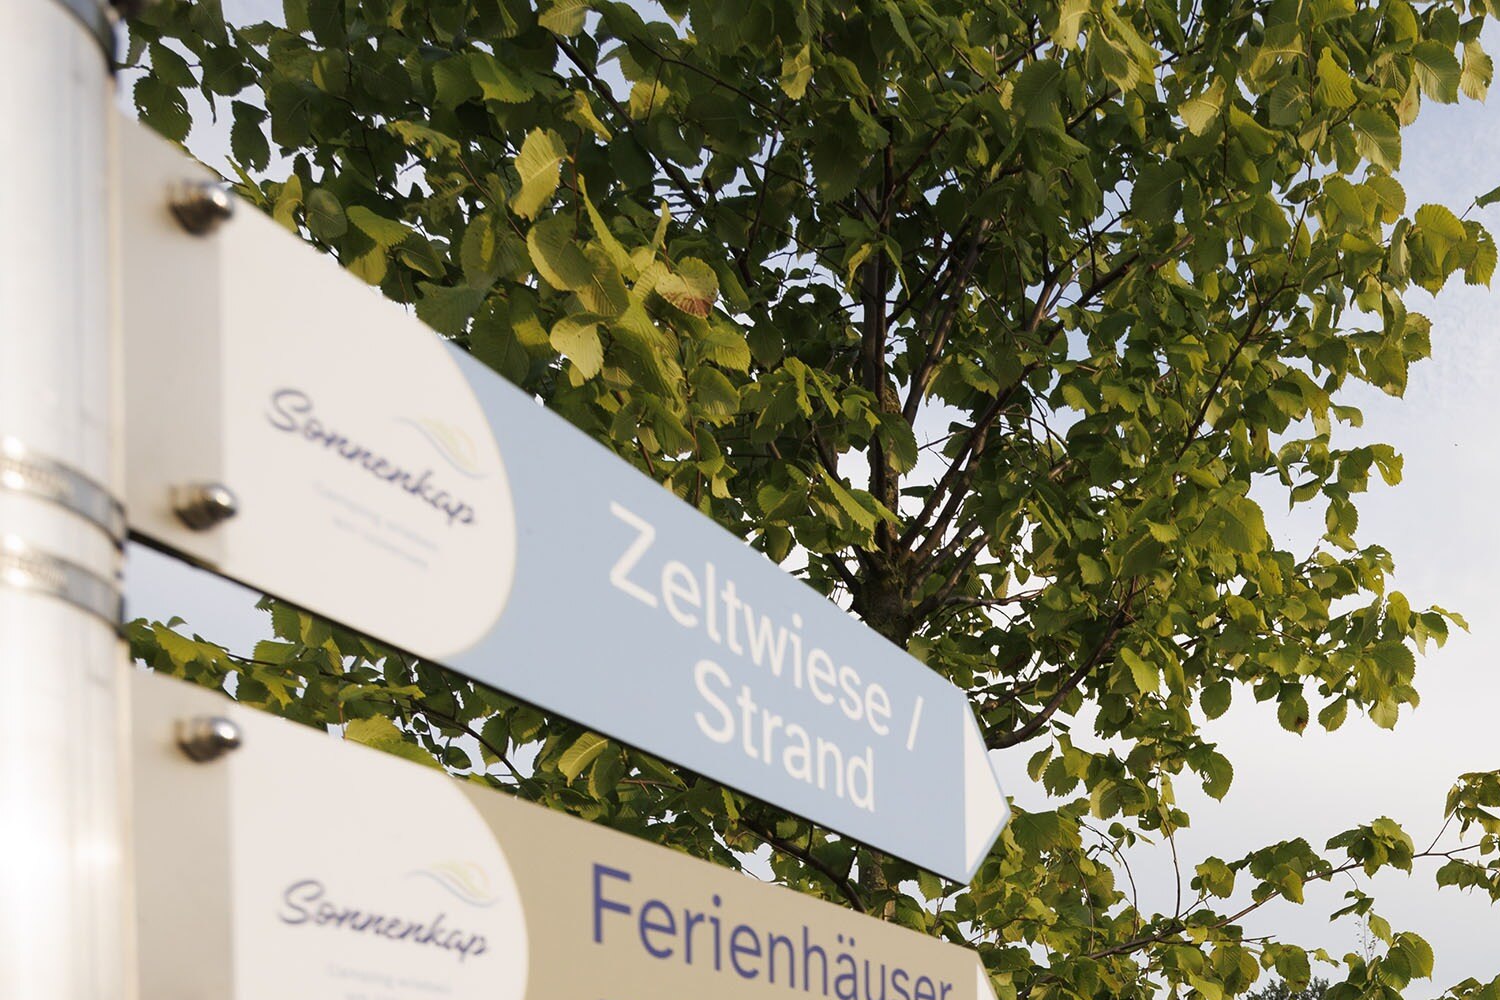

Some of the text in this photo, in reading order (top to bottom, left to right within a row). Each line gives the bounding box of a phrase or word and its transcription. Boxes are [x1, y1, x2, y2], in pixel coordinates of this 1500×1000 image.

[267, 387, 476, 525] Sonnenkap
[609, 500, 893, 737] Zeltwiese
[694, 659, 876, 813] Strand
[279, 878, 489, 961] Sonnenkap
